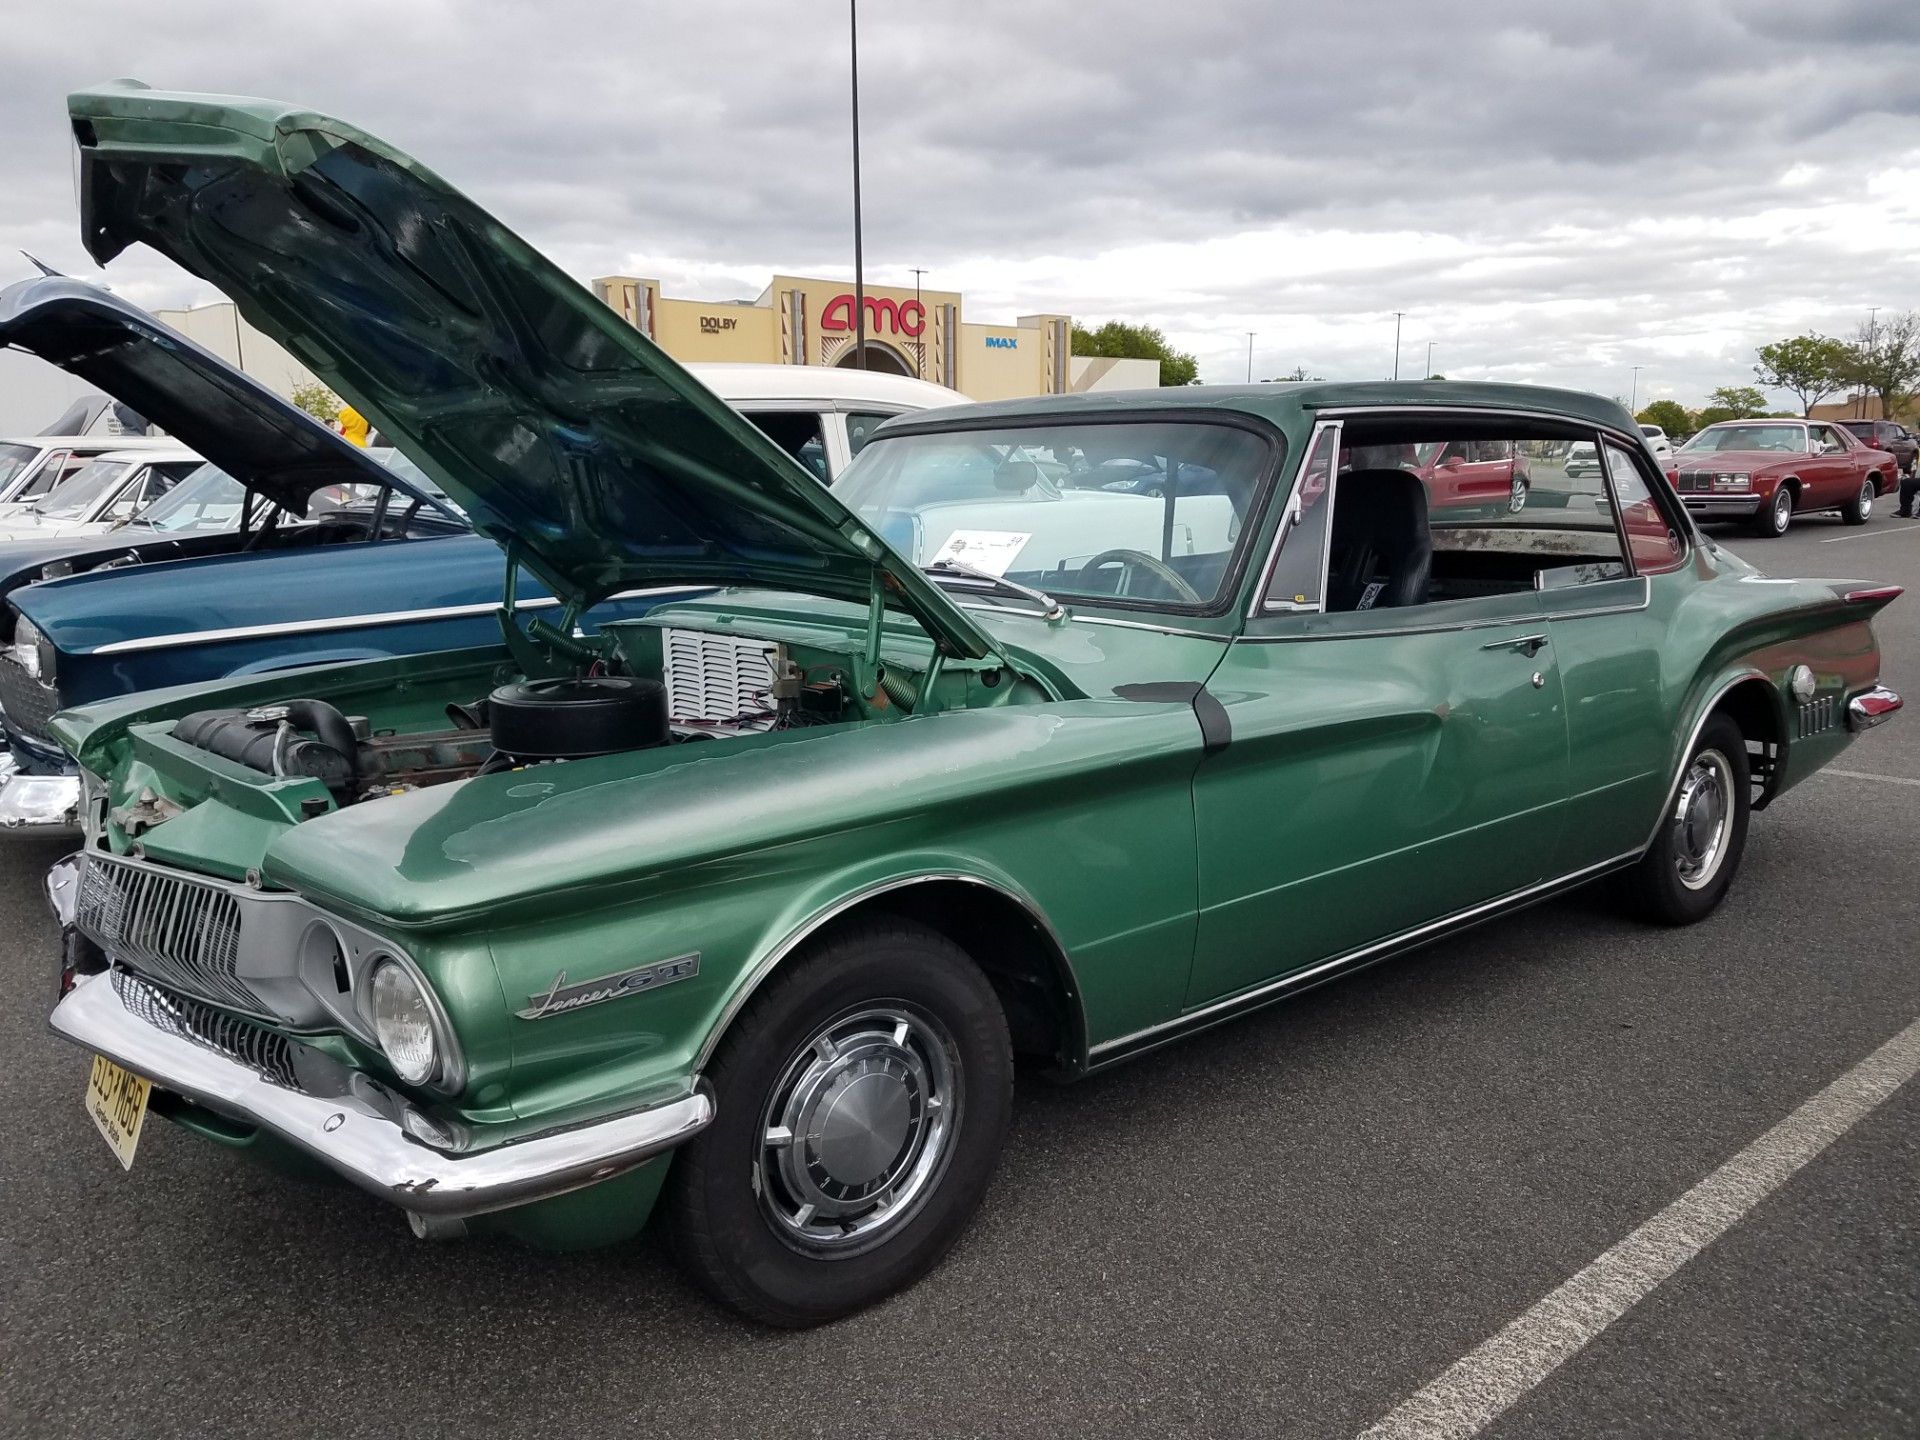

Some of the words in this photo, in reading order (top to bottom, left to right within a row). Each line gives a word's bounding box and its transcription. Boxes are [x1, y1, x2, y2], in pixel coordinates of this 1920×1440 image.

[700, 316, 738, 330] DOLBY
[985, 337, 1018, 350] IMAX
[515, 968, 629, 1020] Lancer
[618, 959, 693, 989] GT
[95, 1101, 110, 1128] Garden
[108, 1120, 120, 1146] State
